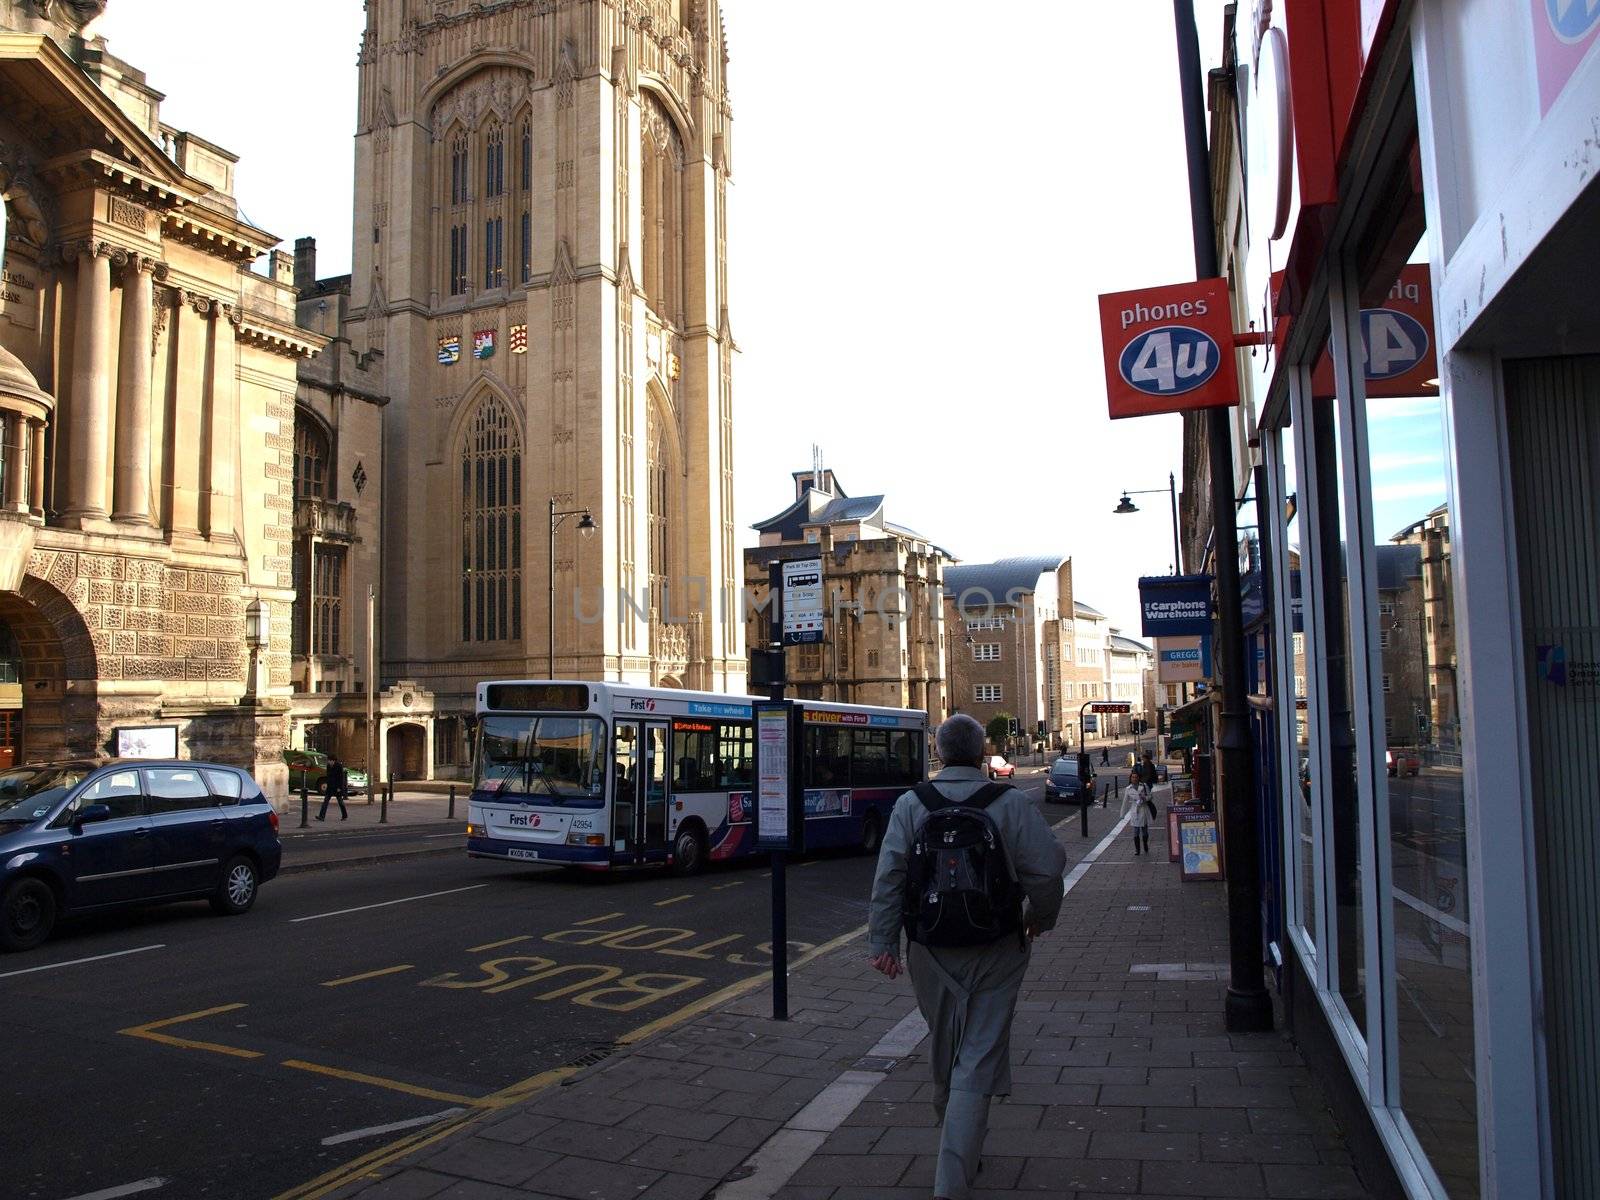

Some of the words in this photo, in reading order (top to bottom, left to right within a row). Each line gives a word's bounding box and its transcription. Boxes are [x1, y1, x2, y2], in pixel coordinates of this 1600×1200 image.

[1120, 299, 1208, 329] phones
[1131, 331, 1211, 391] 4u
[1151, 601, 1206, 611] Carphone
[1146, 610, 1206, 619] Warehouse
[630, 699, 645, 710] First
[694, 704, 712, 713] Take
[723, 705, 744, 715] wheel
[812, 711, 842, 722] driver
[842, 714, 853, 722] with
[854, 715, 866, 723] First
[510, 814, 528, 826] First
[572, 820, 593, 829] 42954
[1187, 828, 1211, 836] LIFE
[1186, 836, 1212, 844] TIME
[542, 925, 816, 967] STOP
[418, 955, 706, 1012] BUS
